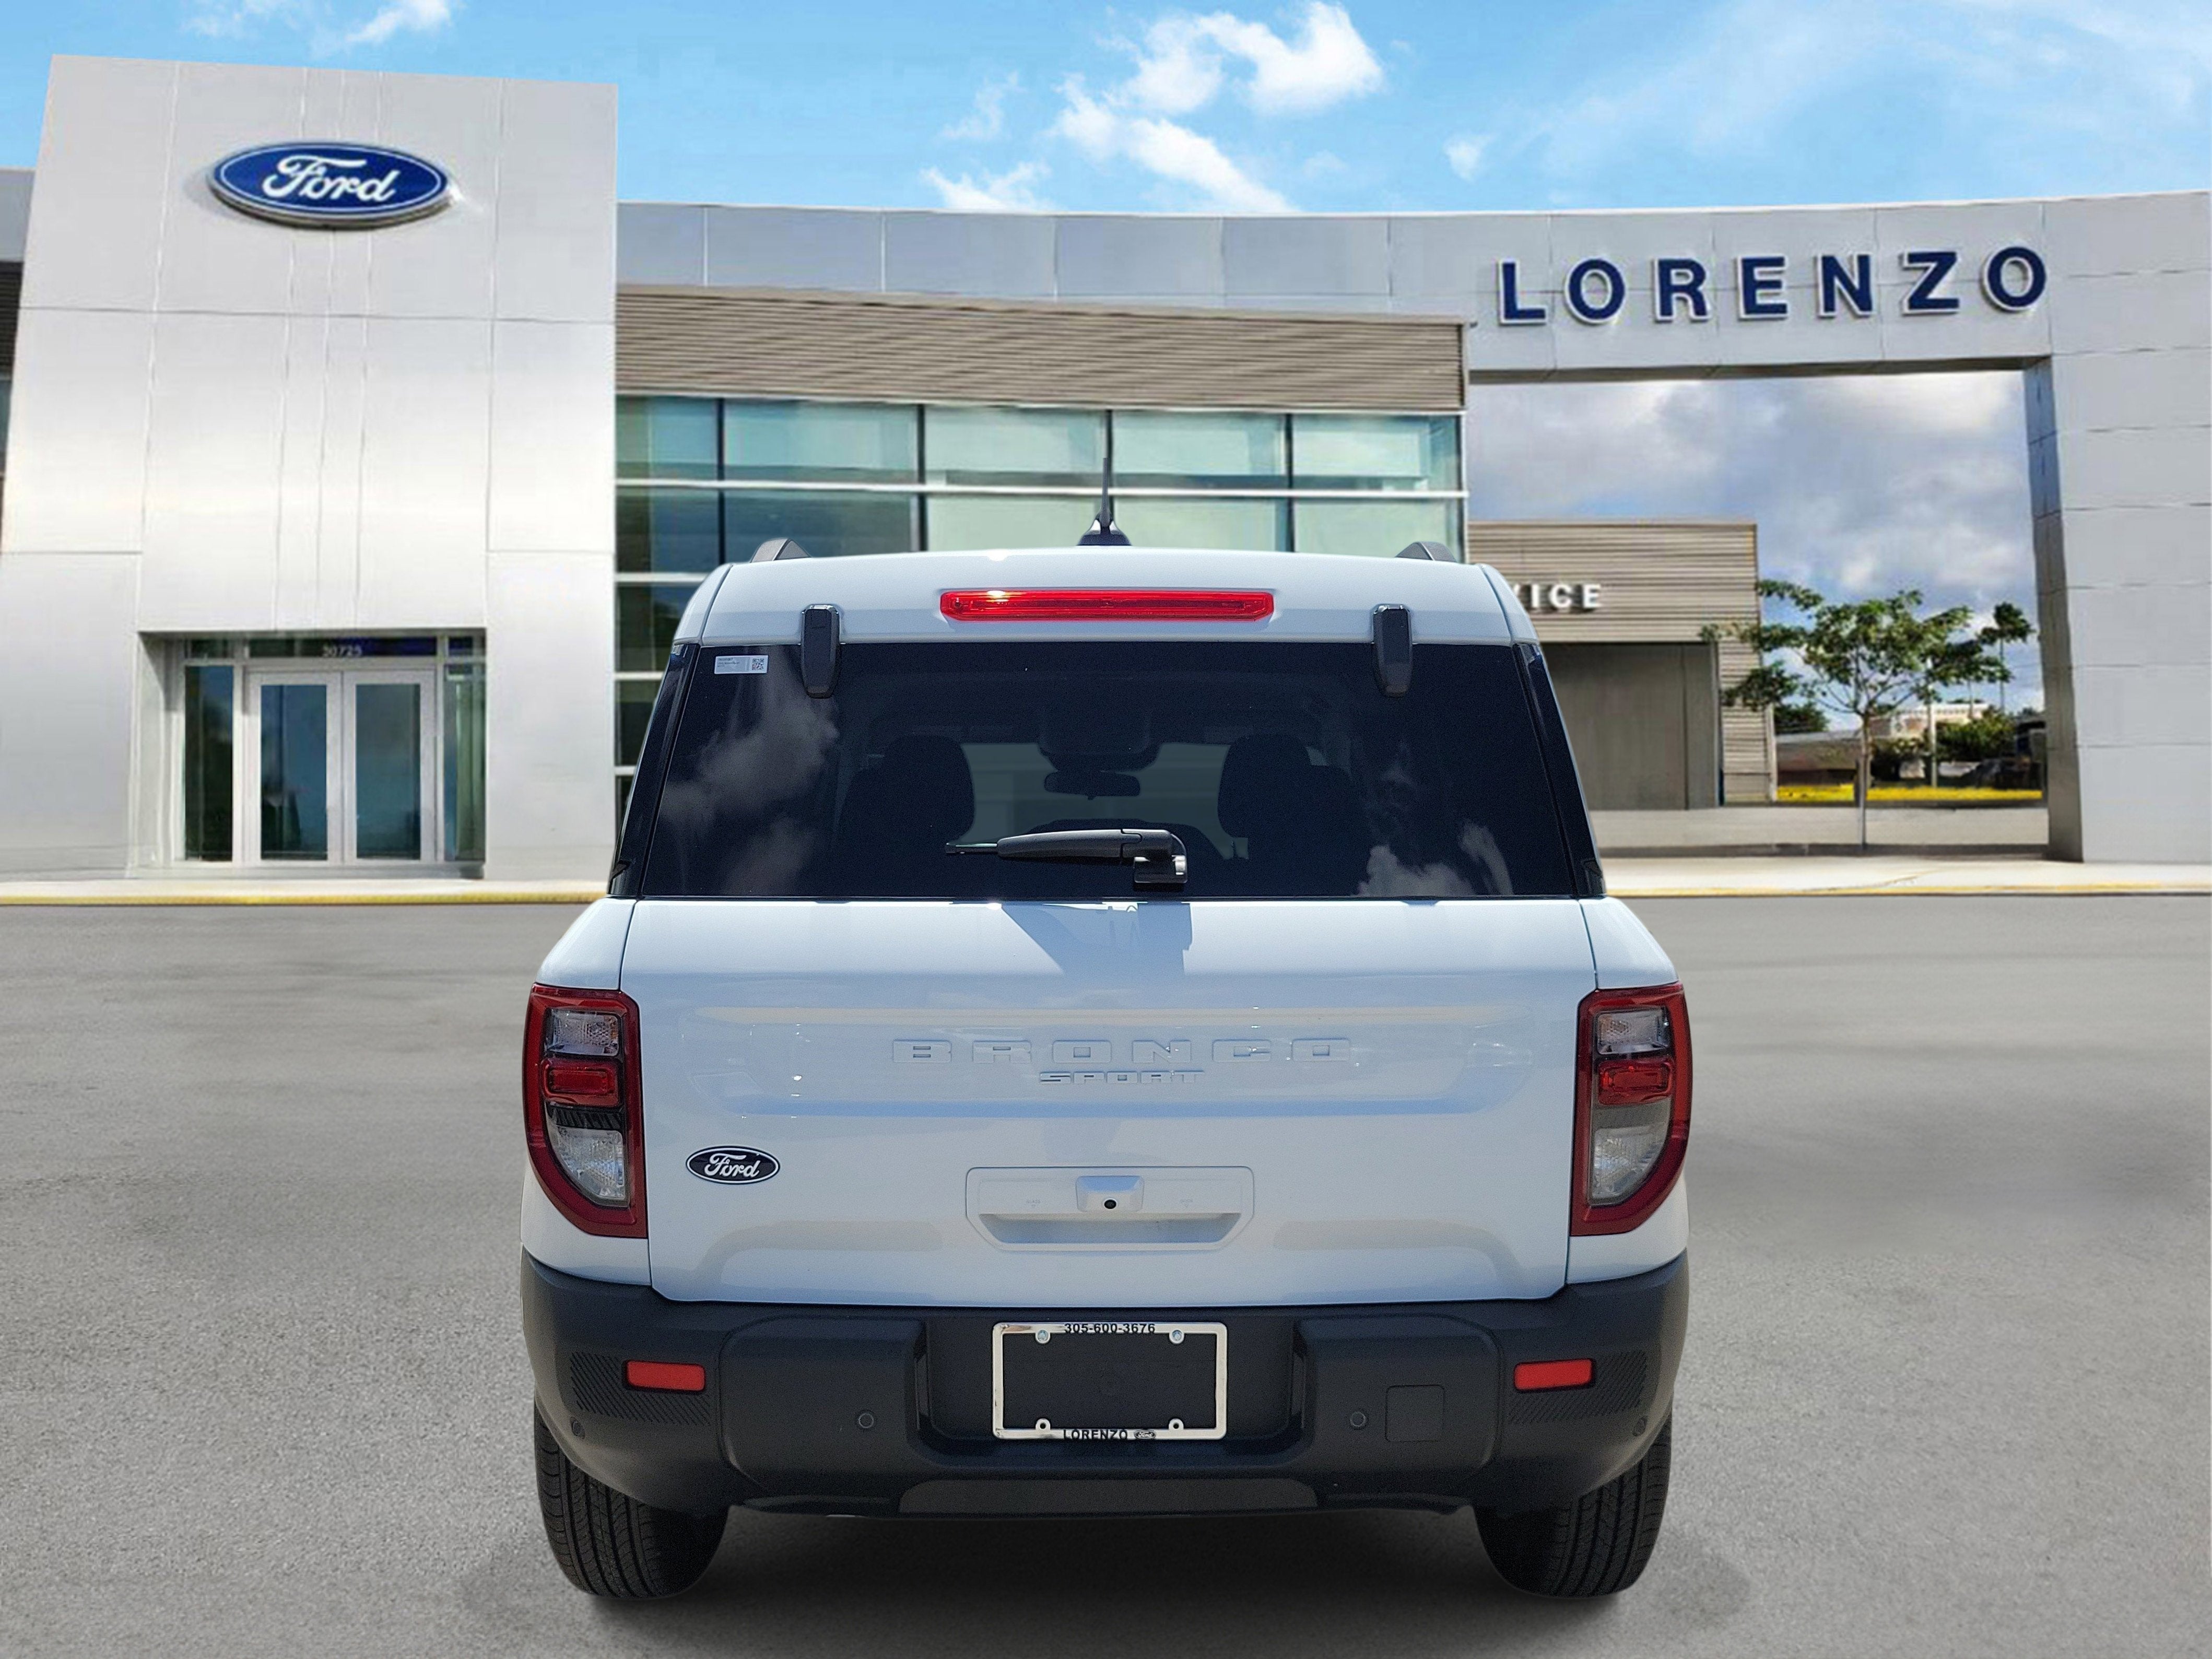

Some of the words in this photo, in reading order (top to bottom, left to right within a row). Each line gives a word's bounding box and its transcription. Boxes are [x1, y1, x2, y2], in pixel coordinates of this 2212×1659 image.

[263, 155, 400, 202] Ford
[1498, 246, 2048, 325] LORENZO
[1513, 584, 1601, 609] ICE
[892, 1038, 1351, 1064] BRONCO
[1039, 1070, 1204, 1084] SPORT
[704, 1152, 761, 1178] Ford
[1064, 1323, 1156, 1334] 305-600-3676
[1063, 1428, 1128, 1440] LORENZO
